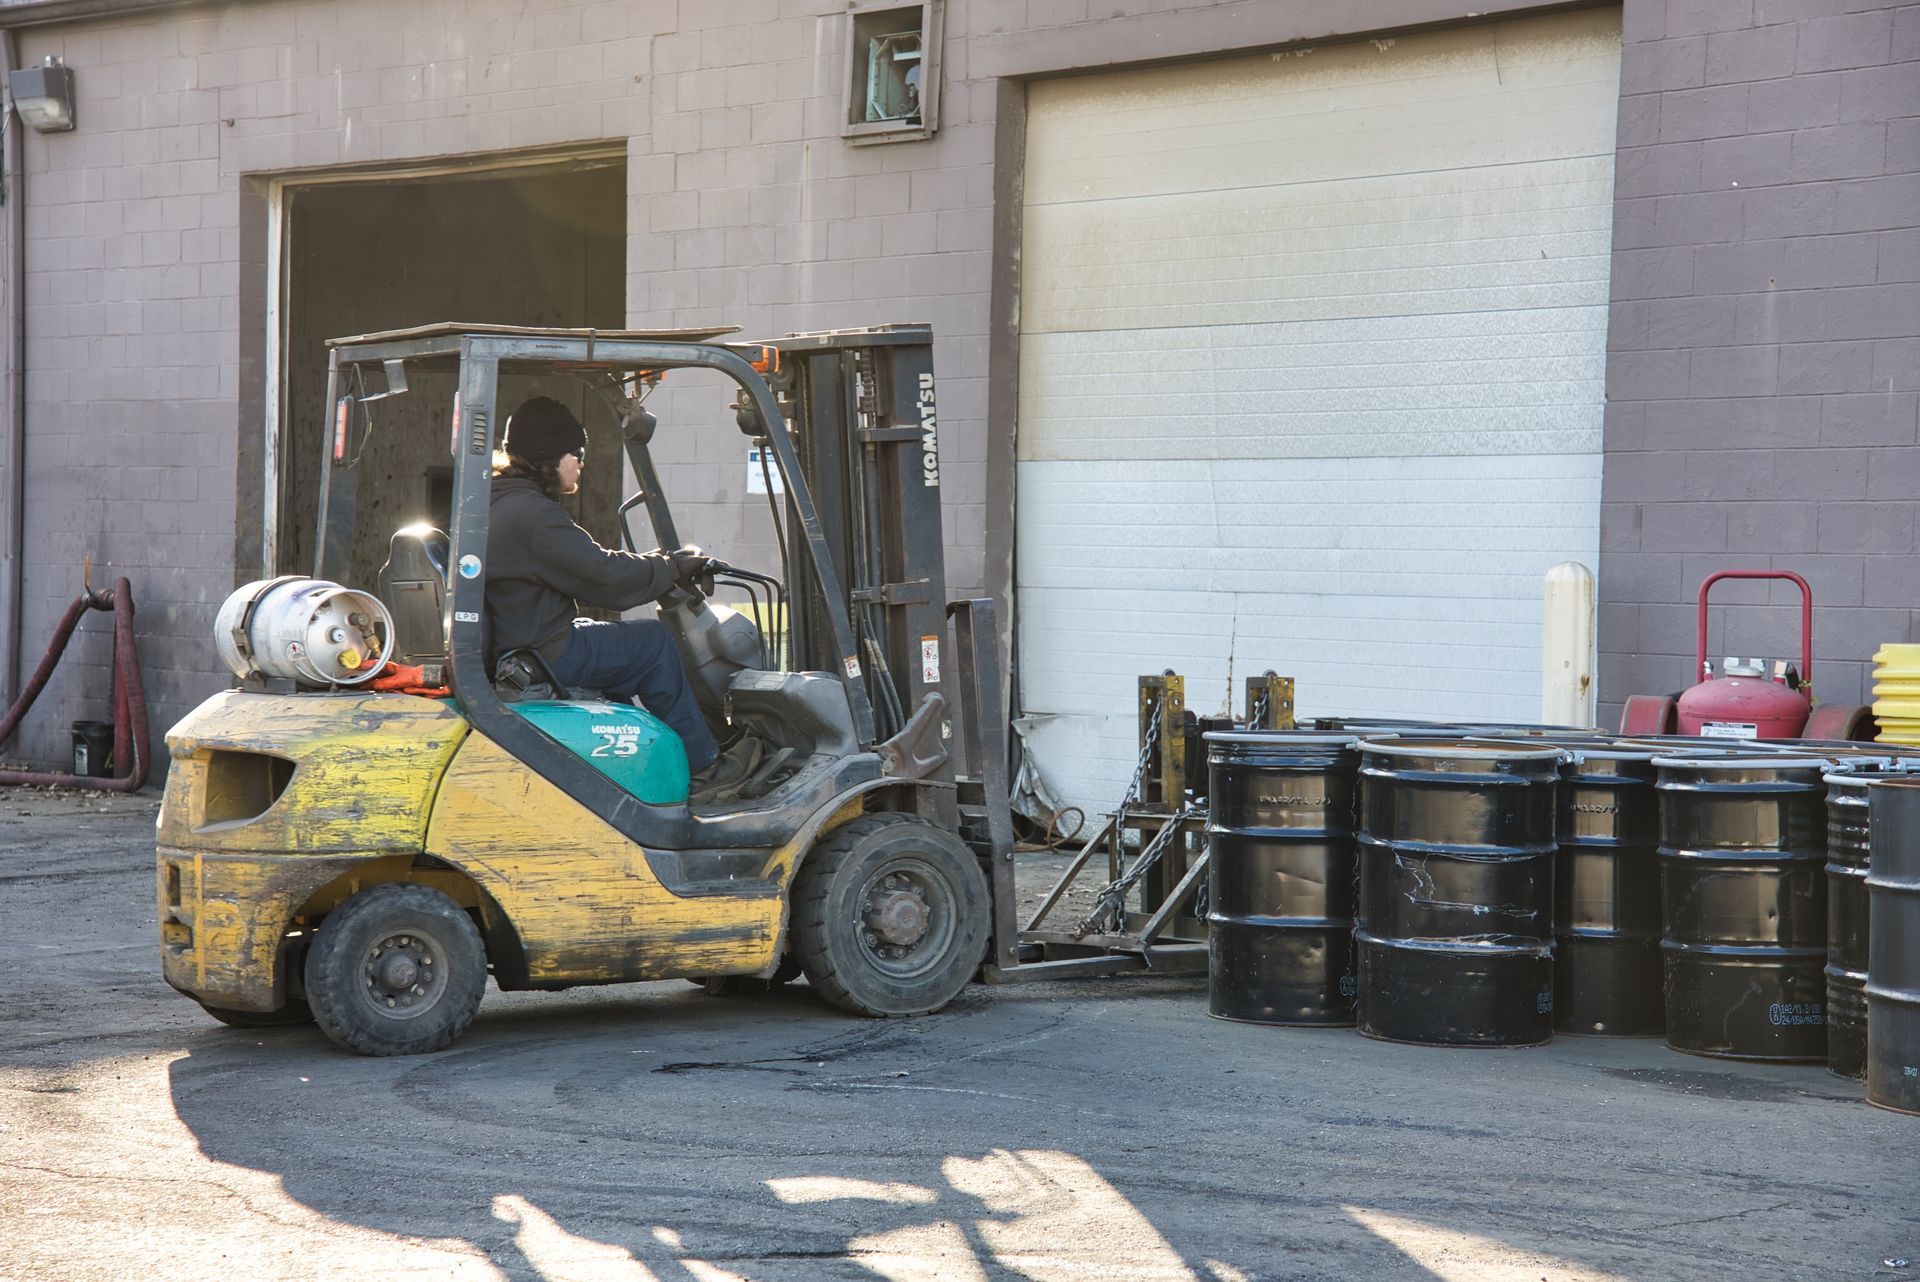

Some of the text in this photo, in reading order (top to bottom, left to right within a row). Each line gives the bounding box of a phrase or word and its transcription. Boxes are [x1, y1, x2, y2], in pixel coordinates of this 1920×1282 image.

[916, 373, 939, 487] KOMATSU
[457, 613, 477, 621] LPG
[592, 724, 640, 735] KOMATSU
[591, 735, 638, 758] 25
